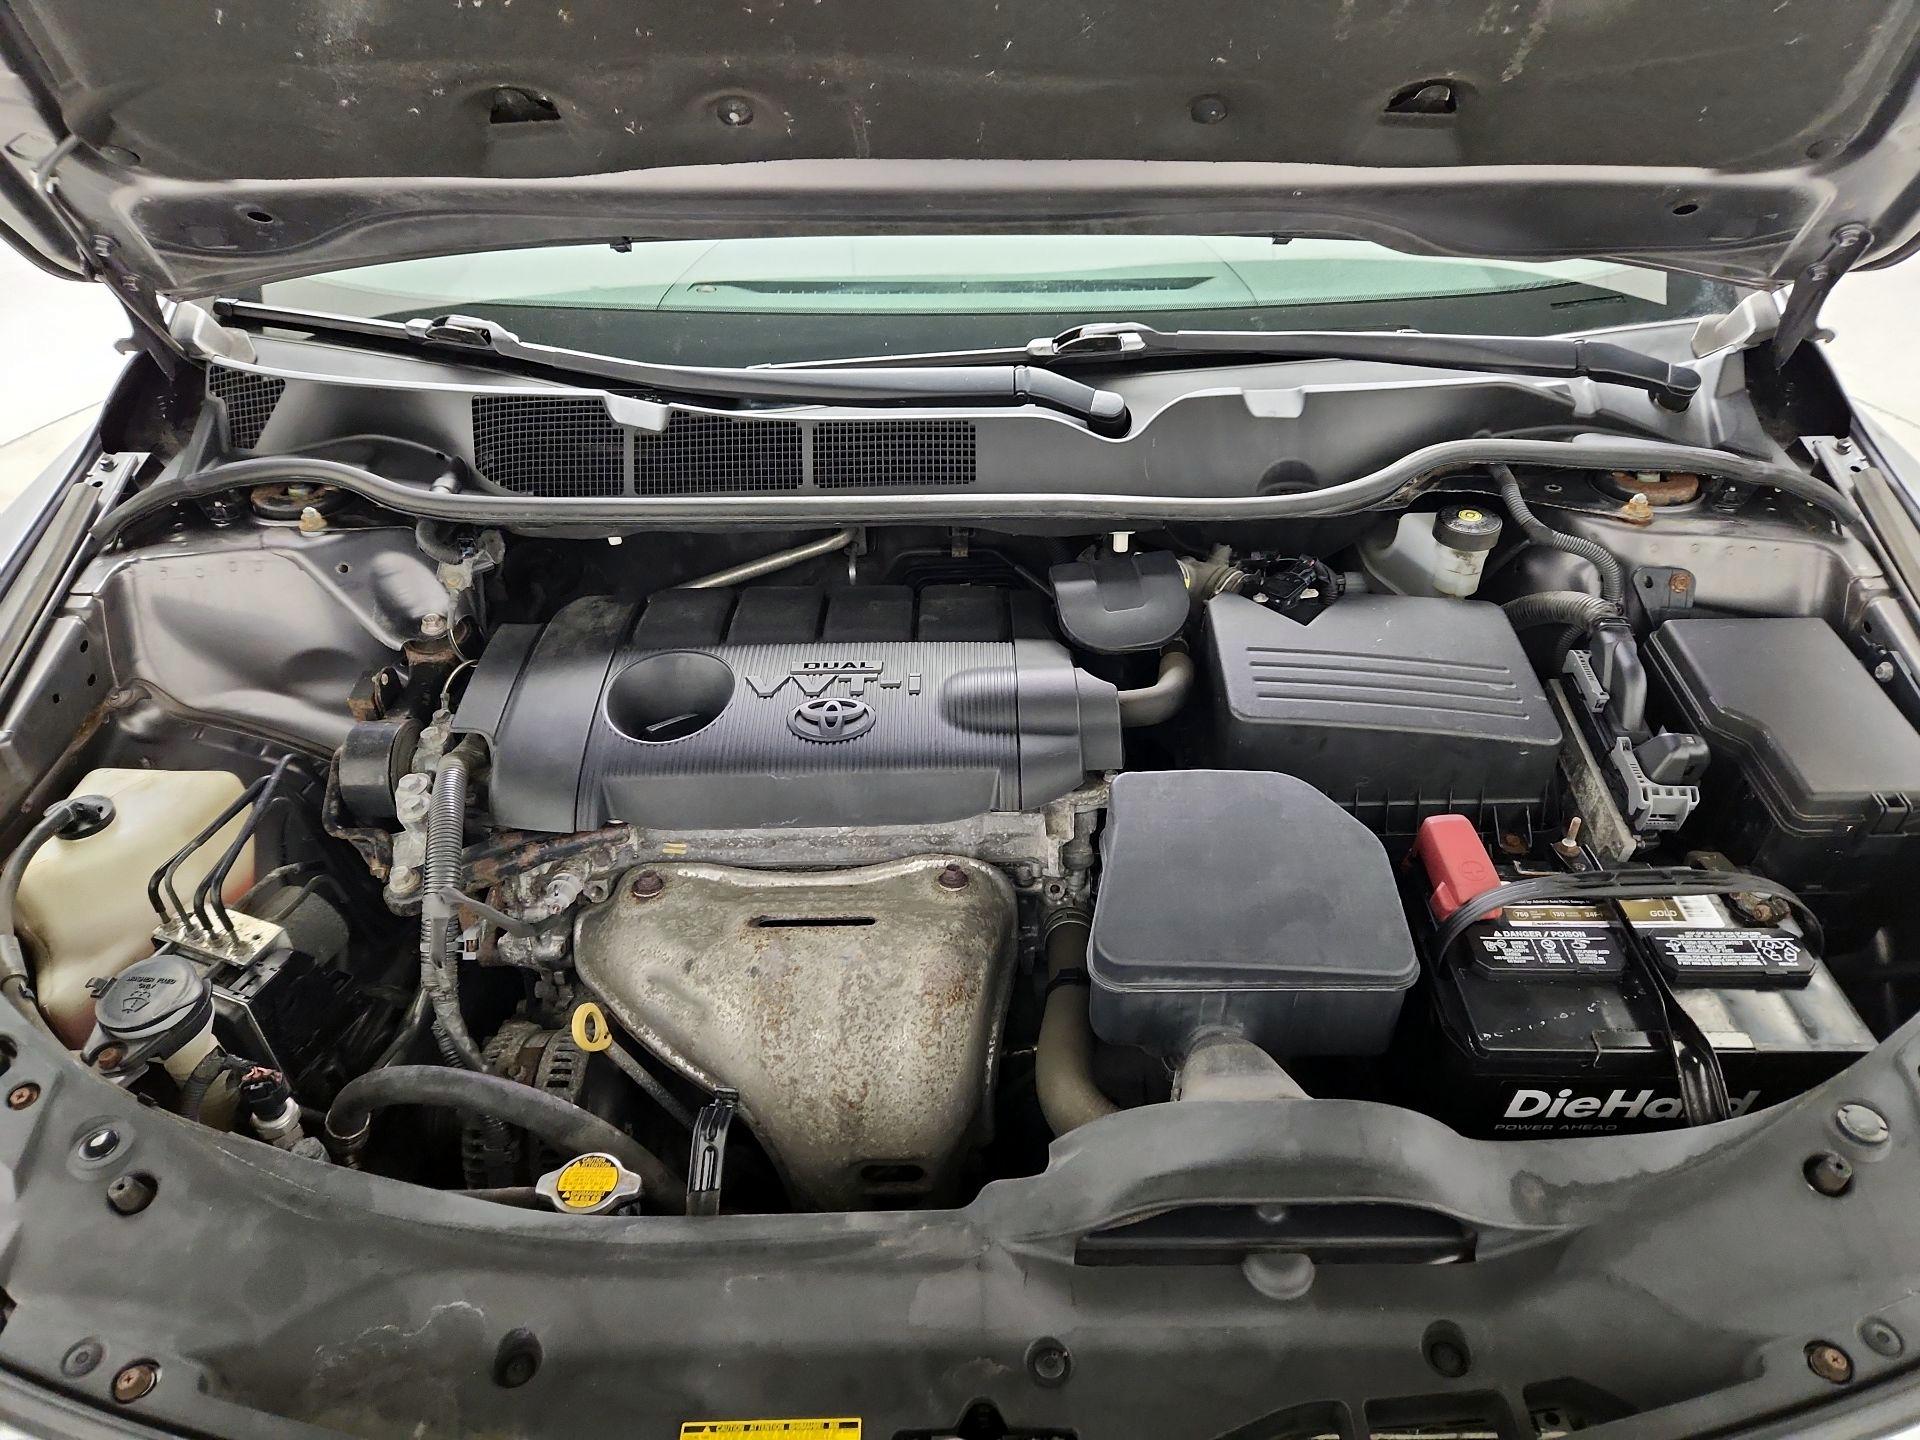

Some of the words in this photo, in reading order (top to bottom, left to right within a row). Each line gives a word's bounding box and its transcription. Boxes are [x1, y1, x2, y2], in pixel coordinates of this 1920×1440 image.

[803, 661, 874, 669] DUAL
[745, 672, 922, 698] VVT-i
[1650, 909, 1677, 917] GOLD
[1502, 930, 1542, 938] DANGER
[1551, 930, 1587, 938] POISON
[1503, 1088, 1762, 1119] DieHad
